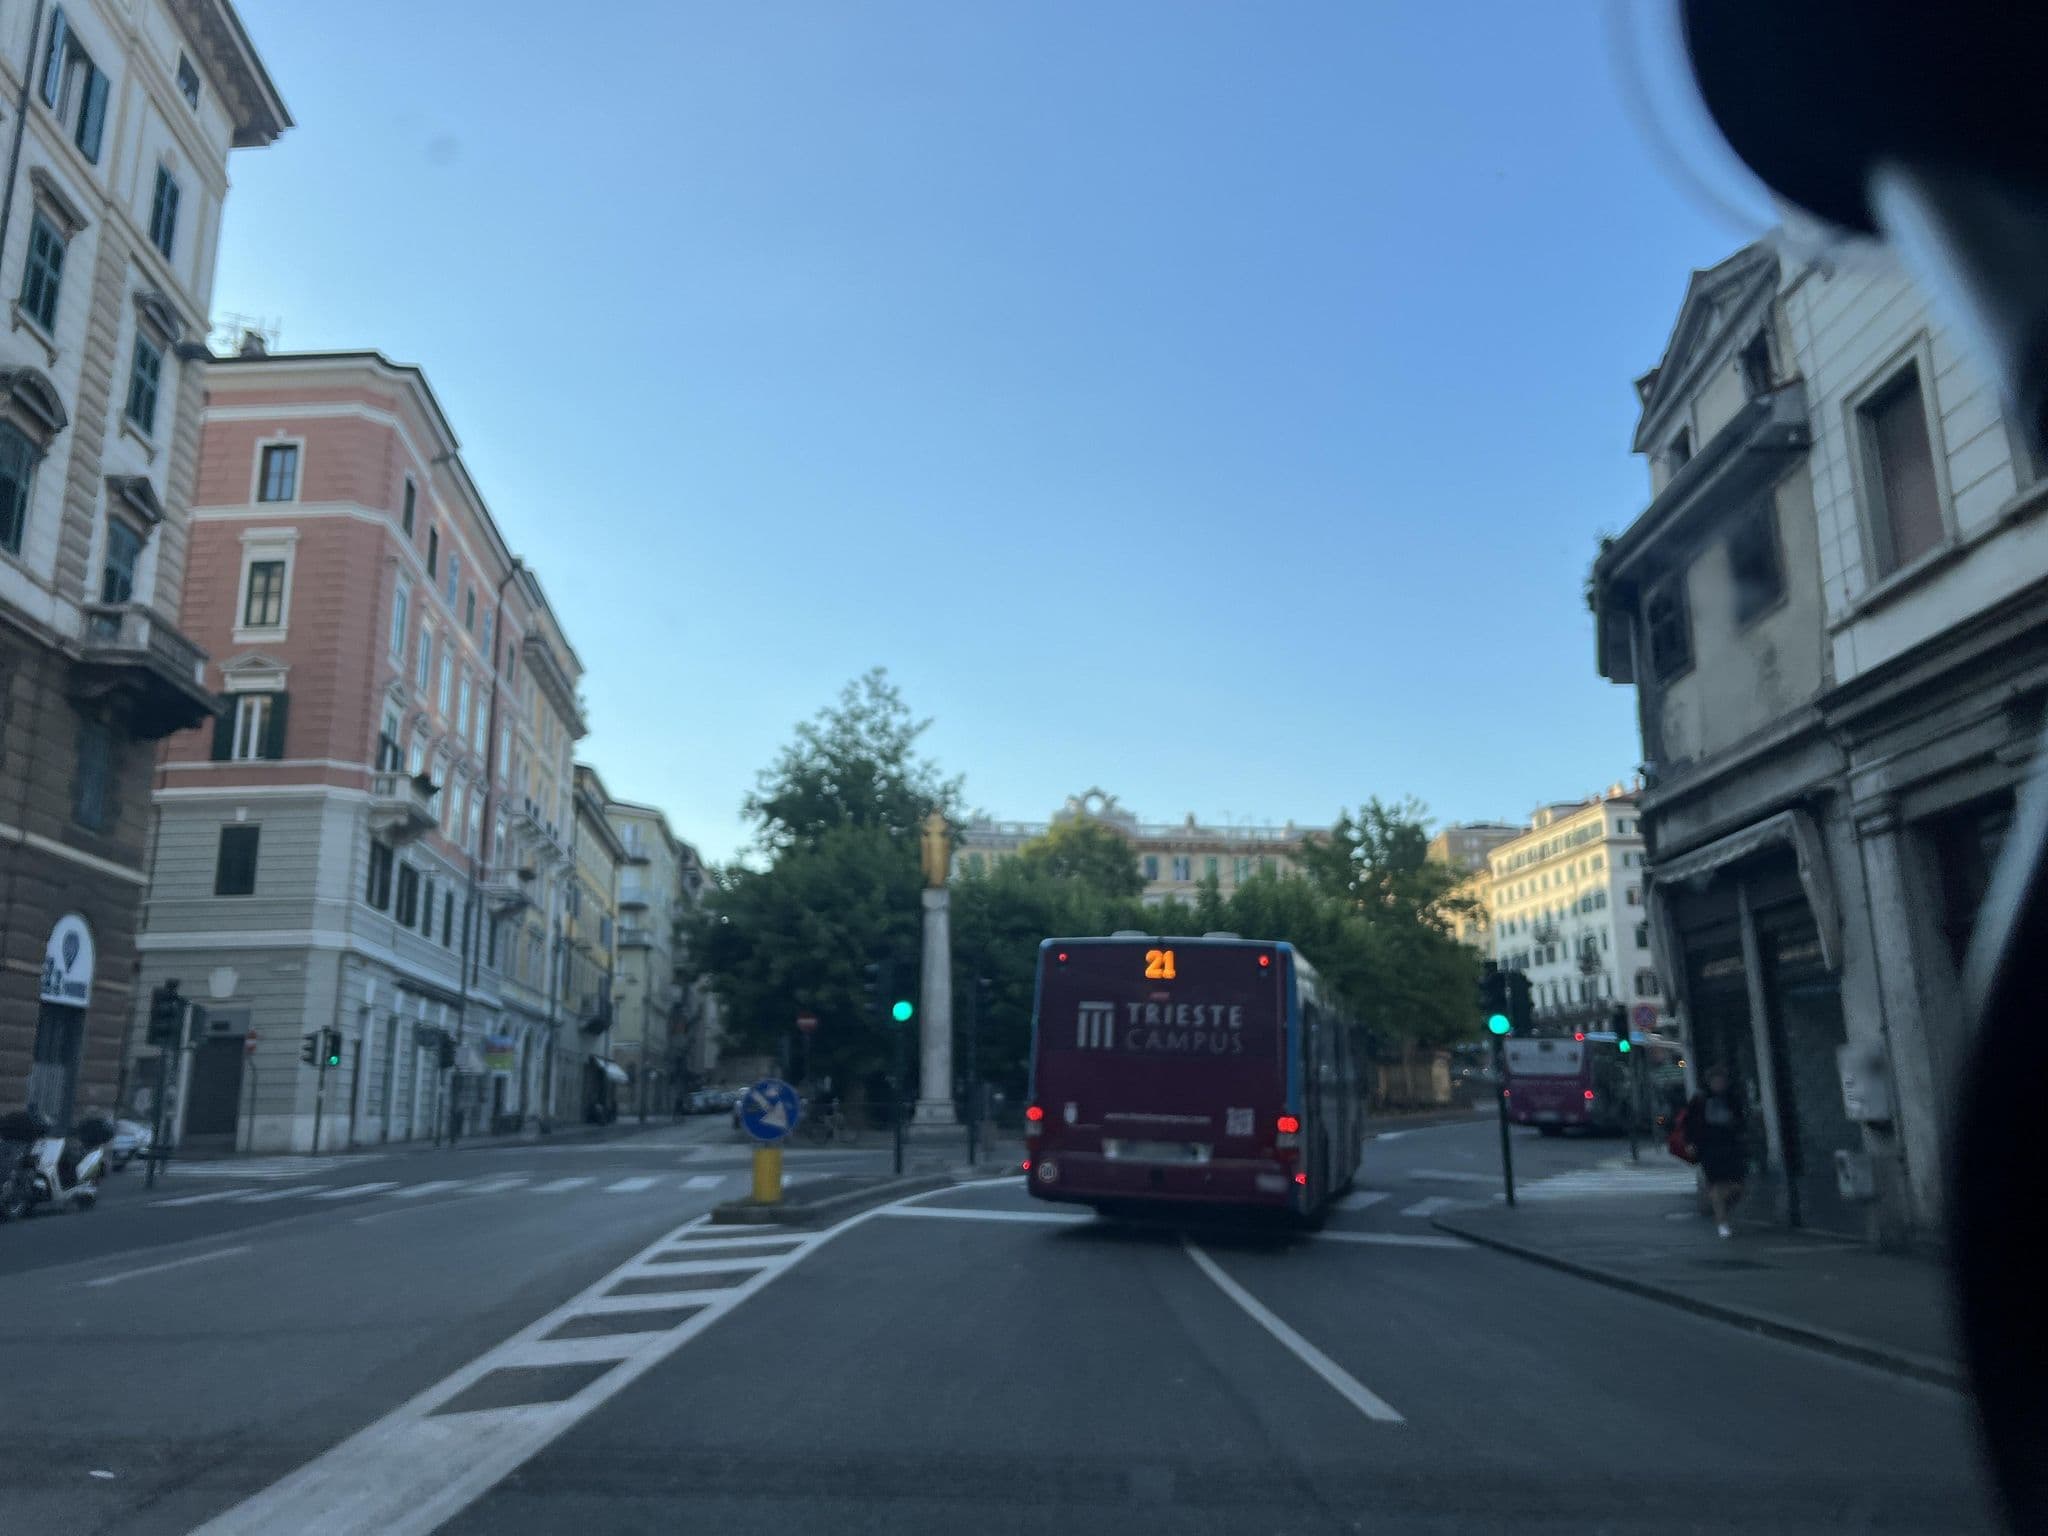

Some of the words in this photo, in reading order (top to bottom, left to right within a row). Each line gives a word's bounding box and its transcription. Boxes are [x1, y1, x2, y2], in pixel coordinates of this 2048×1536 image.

[1145, 950, 1176, 979] 21
[1127, 1002, 1242, 1027] TRIESTE
[1127, 1029, 1242, 1054] CAMPUS
